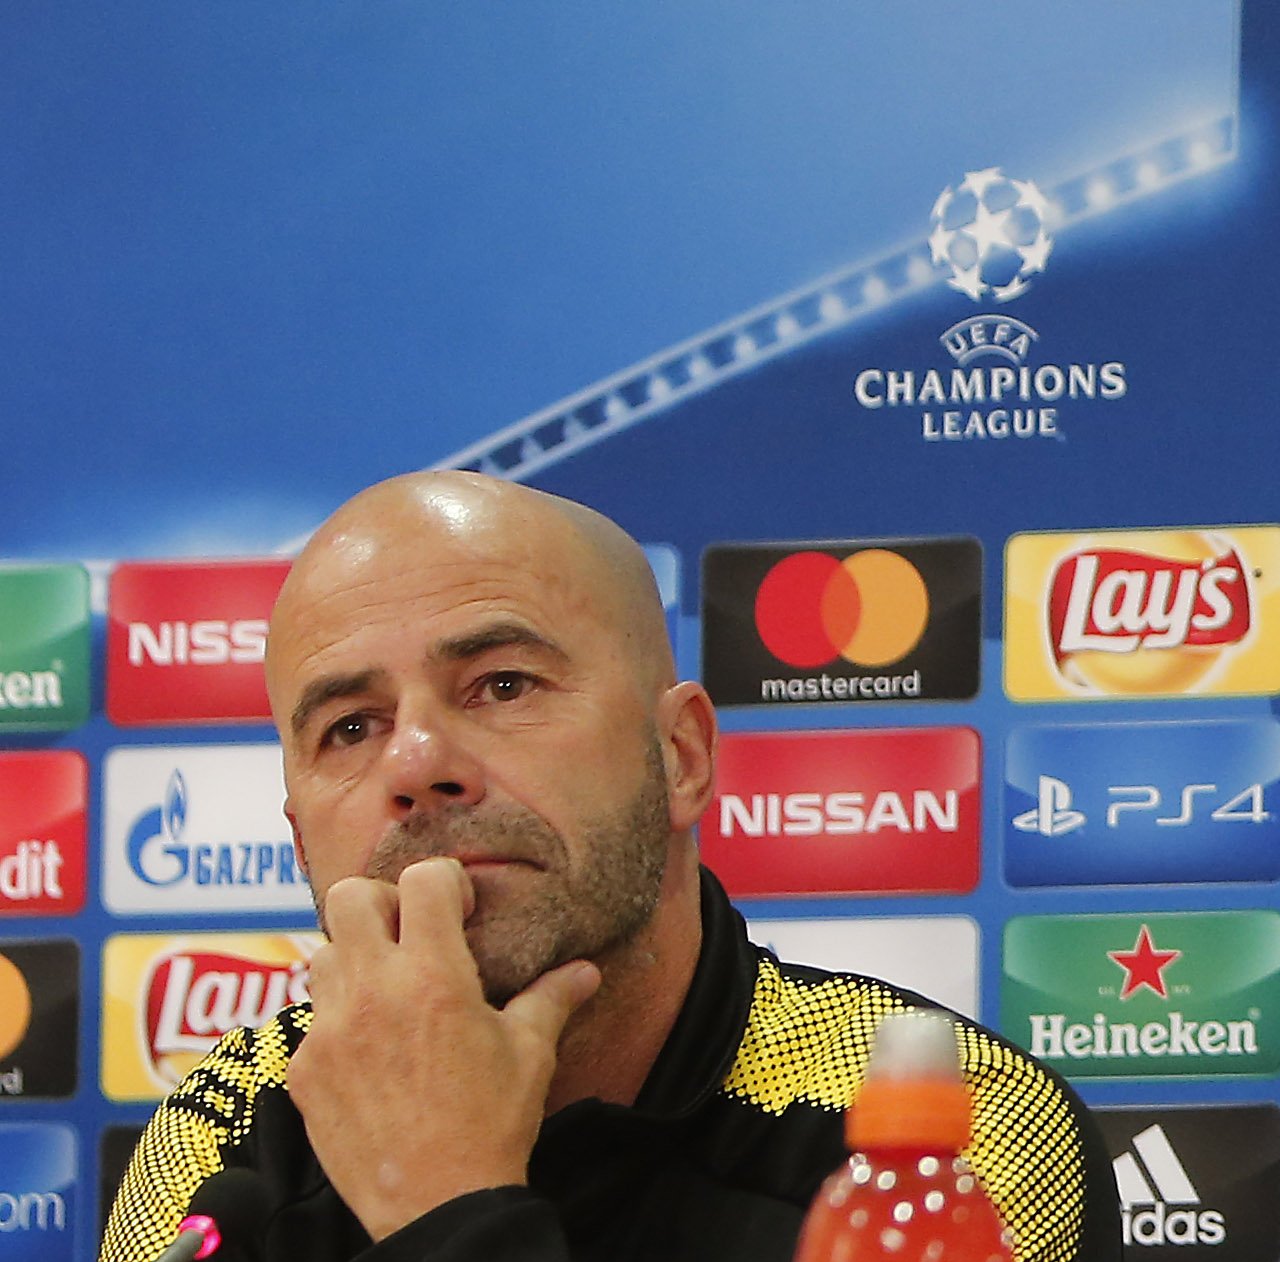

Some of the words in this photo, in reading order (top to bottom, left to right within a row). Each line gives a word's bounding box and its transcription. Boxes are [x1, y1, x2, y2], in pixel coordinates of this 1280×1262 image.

[945, 323, 1031, 360] UEFA
[854, 361, 1128, 409] CHAMPIONS
[922, 407, 1058, 442] LEAGUE
[1058, 553, 1239, 654] Lay's
[128, 619, 270, 666] NISS
[760, 669, 921, 700] mastercard
[719, 790, 959, 837] NISSAN
[1106, 784, 1271, 827] PS4
[195, 842, 309, 886] GAZPR
[1029, 1012, 1259, 1059] Heineken
[1121, 1201, 1227, 1246] idas
